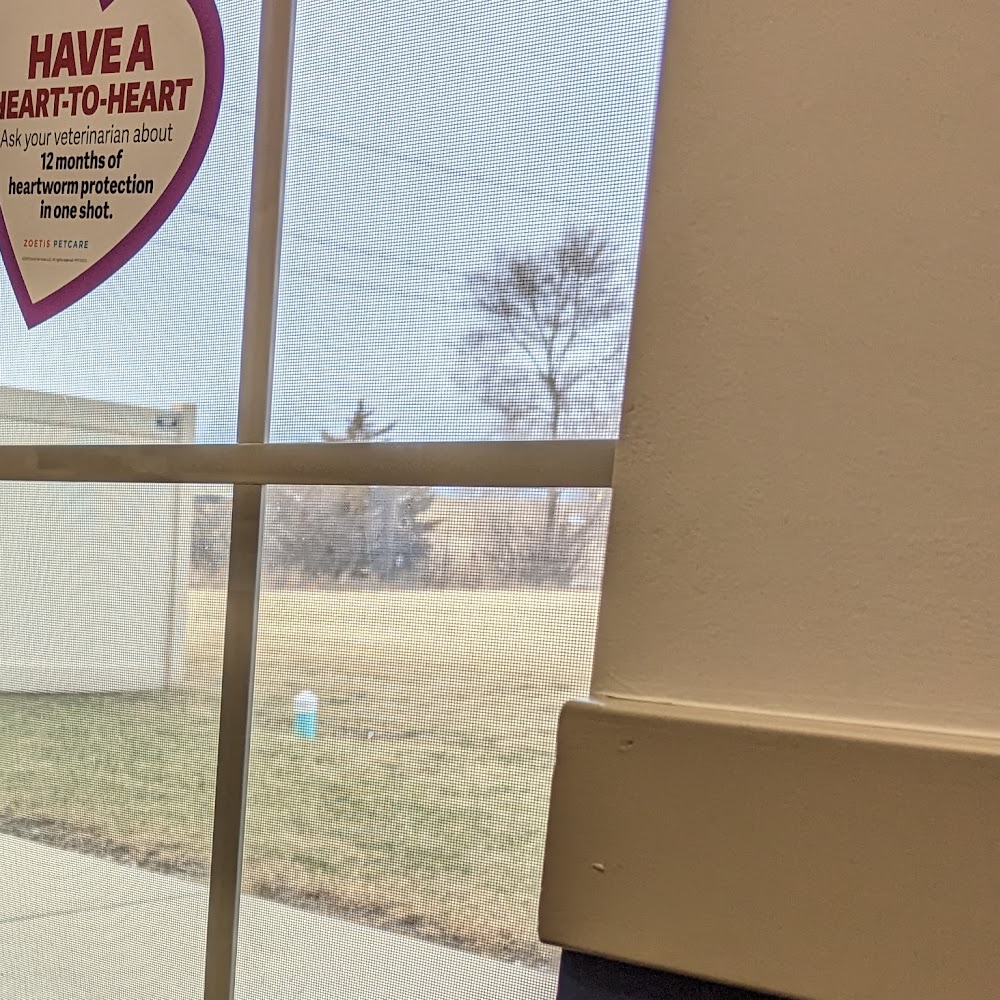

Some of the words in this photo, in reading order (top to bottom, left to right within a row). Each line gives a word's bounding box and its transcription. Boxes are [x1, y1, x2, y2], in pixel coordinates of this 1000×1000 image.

[28, 26, 124, 80] HAVE
[126, 24, 154, 72] A
[0, 128, 22, 148] Ask
[24, 131, 52, 151] your
[54, 124, 130, 146] veterinarian
[133, 123, 174, 143] about
[40, 152, 54, 170] 12
[55, 151, 105, 170] months
[107, 149, 124, 169] of
[8, 177, 79, 196] heartworm
[80, 174, 154, 199] protection
[40, 200, 52, 219] in
[53, 203, 77, 219] one
[79, 201, 113, 220] shot.
[23, 239, 51, 248] ZOETIS
[53, 240, 89, 249] PETCARE
